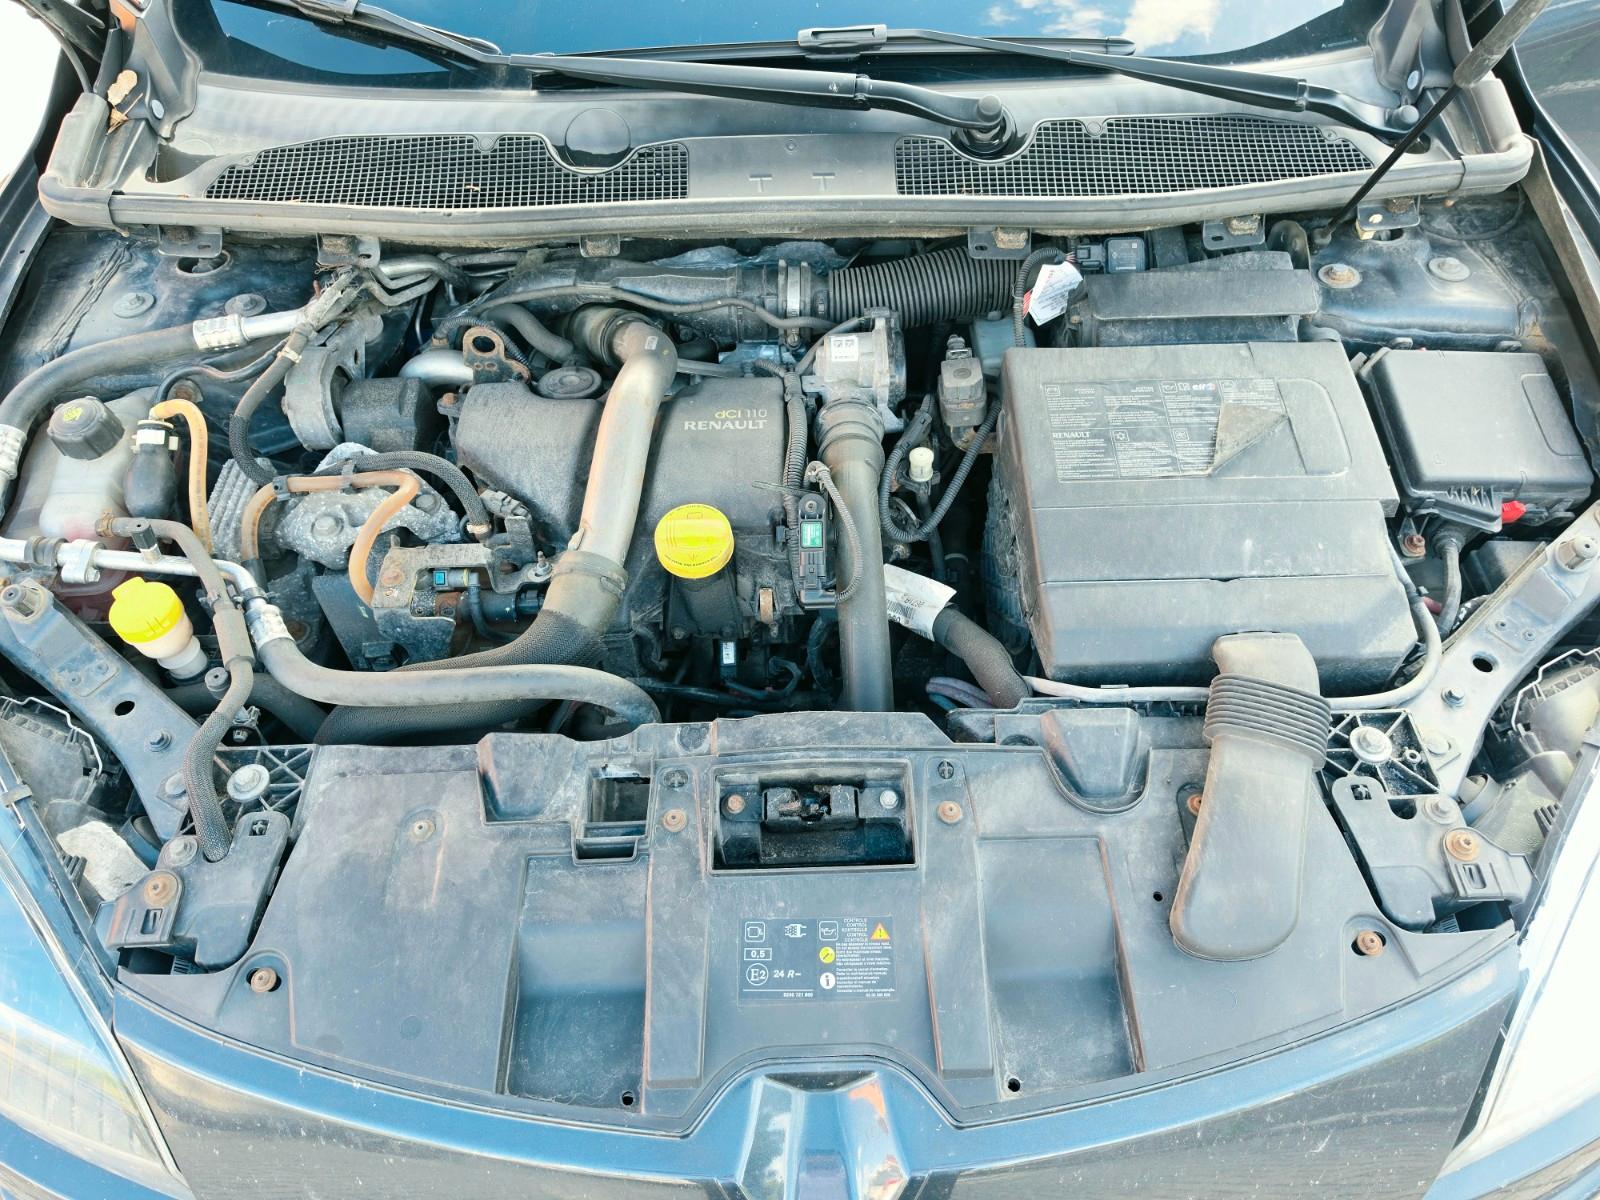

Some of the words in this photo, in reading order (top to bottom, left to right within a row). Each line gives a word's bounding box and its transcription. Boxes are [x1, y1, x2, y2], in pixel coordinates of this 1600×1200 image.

[744, 408, 768, 418] 110
[684, 419, 768, 431] RENAULT
[1052, 431, 1091, 439] RENAULT
[750, 950, 766, 958] 0,5
[750, 968, 767, 981] E2
[773, 969, 785, 978] 24
